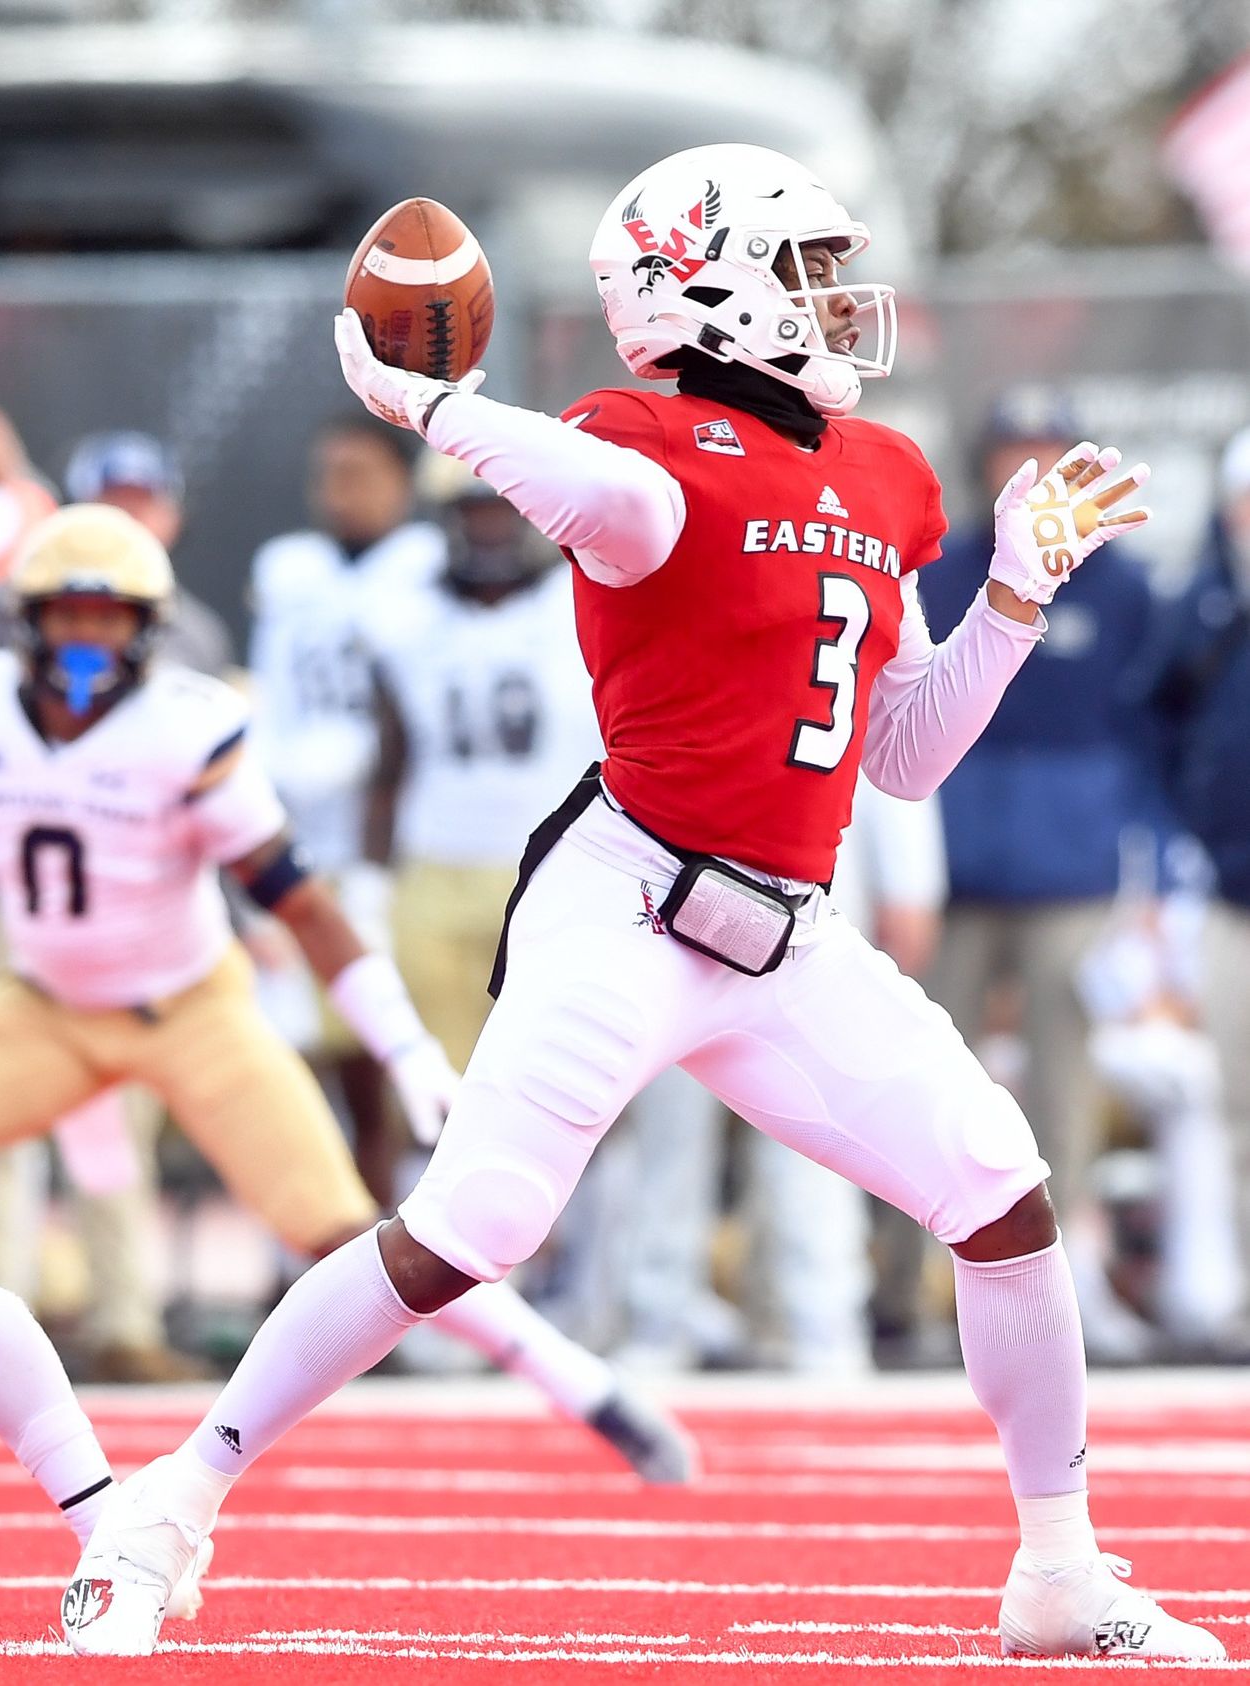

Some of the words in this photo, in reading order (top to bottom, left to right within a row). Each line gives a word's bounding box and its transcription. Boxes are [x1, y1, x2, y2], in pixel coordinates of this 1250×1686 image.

[742, 519, 901, 579] EASTERN
[787, 572, 872, 775] 3
[214, 1425, 243, 1455] adidas
